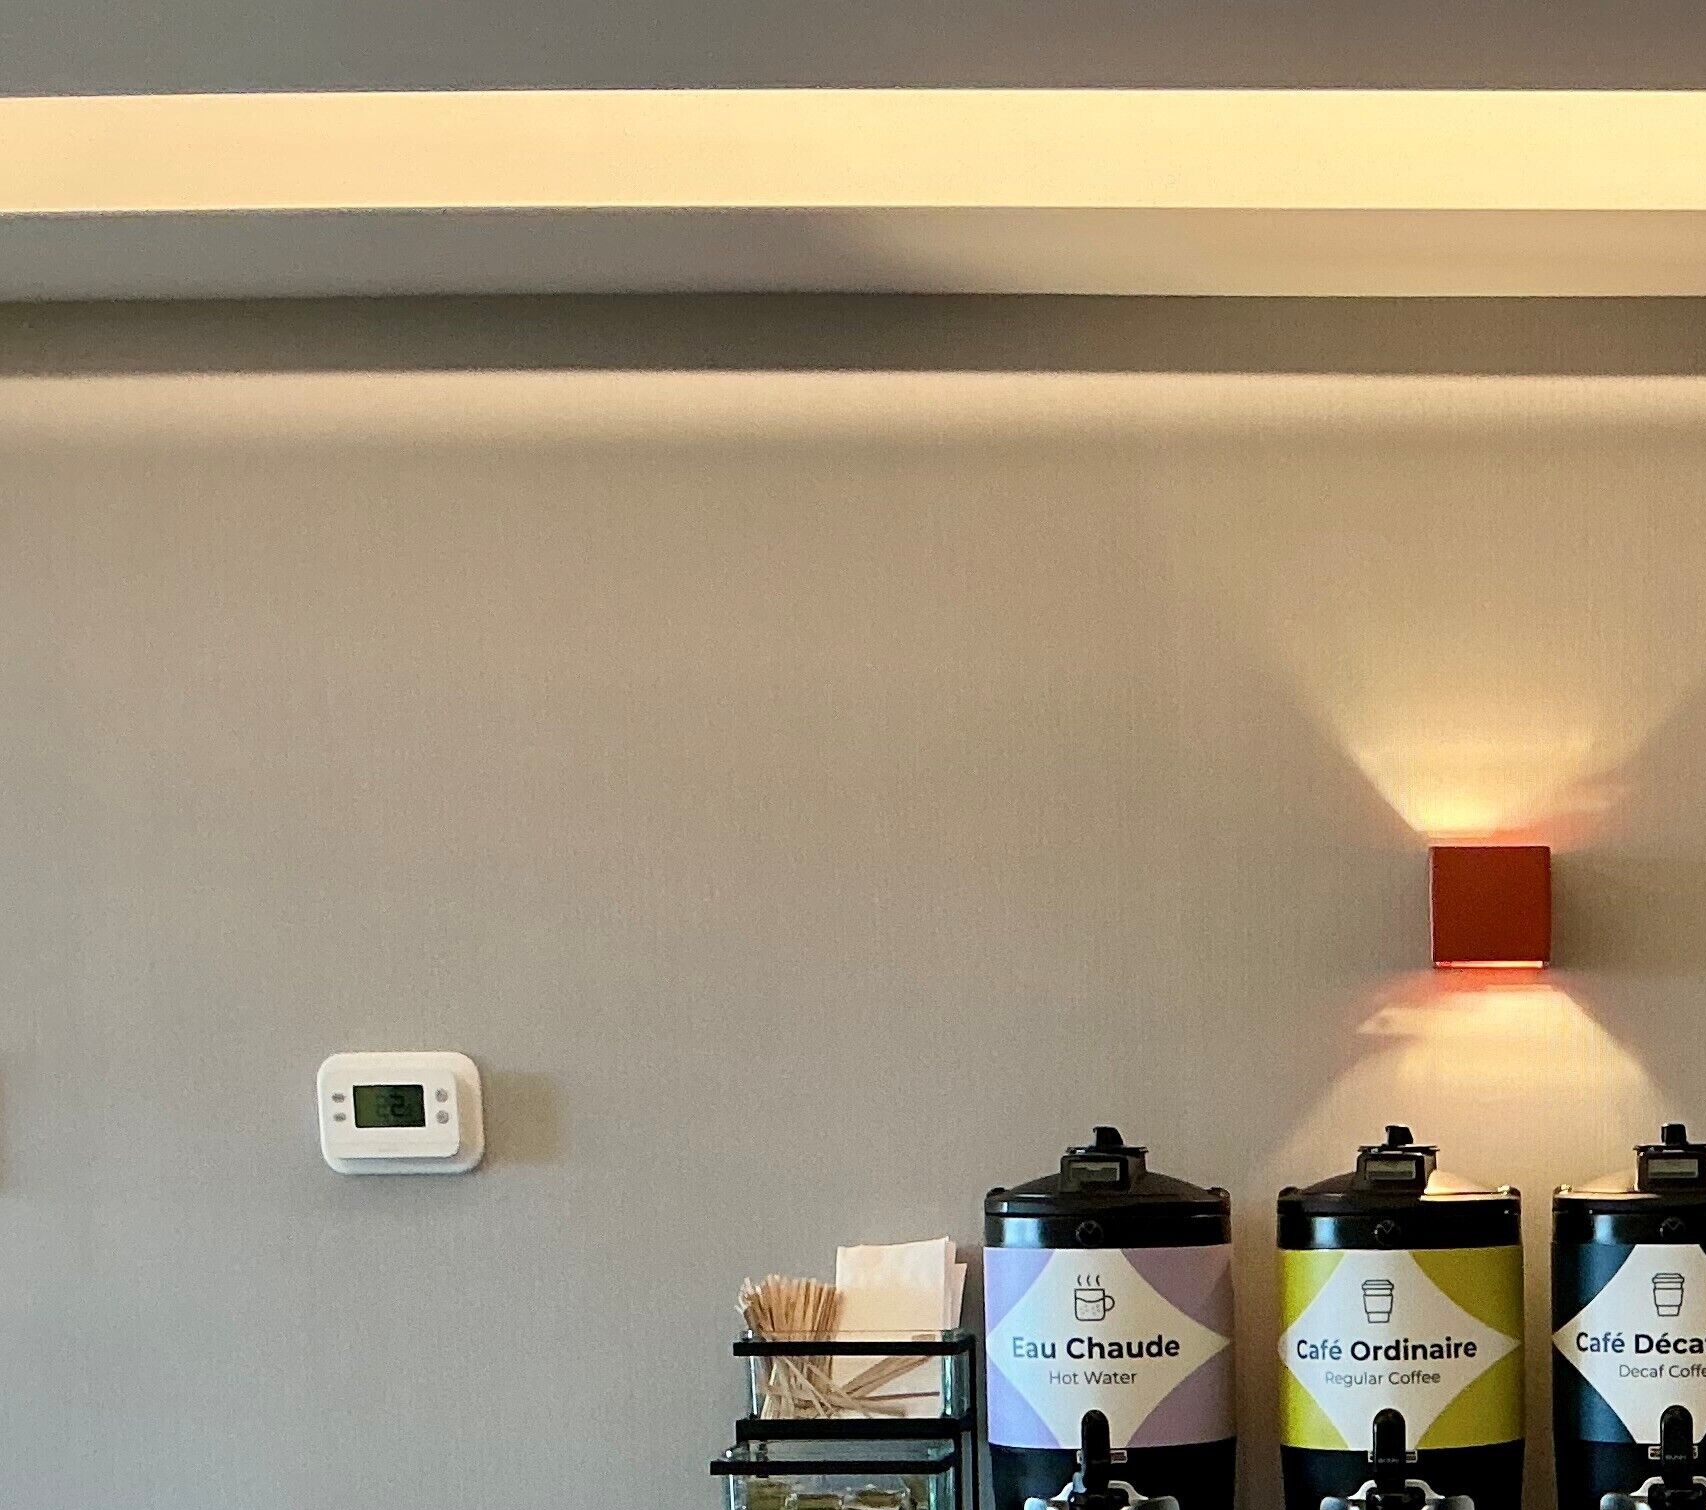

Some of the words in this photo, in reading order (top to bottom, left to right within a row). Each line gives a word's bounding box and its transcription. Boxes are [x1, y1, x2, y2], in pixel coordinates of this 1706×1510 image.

[1012, 1336, 1056, 1359] Eau
[1066, 1334, 1181, 1360] Chaude
[1297, 1338, 1343, 1361] Café
[1350, 1336, 1478, 1362] Ordinaire
[1576, 1331, 1626, 1354] Café
[1049, 1370, 1079, 1385] Hot
[1083, 1370, 1138, 1385] Water
[1325, 1371, 1384, 1388] Regular
[1388, 1369, 1442, 1385] Coffee
[1618, 1364, 1665, 1379] Decaf
